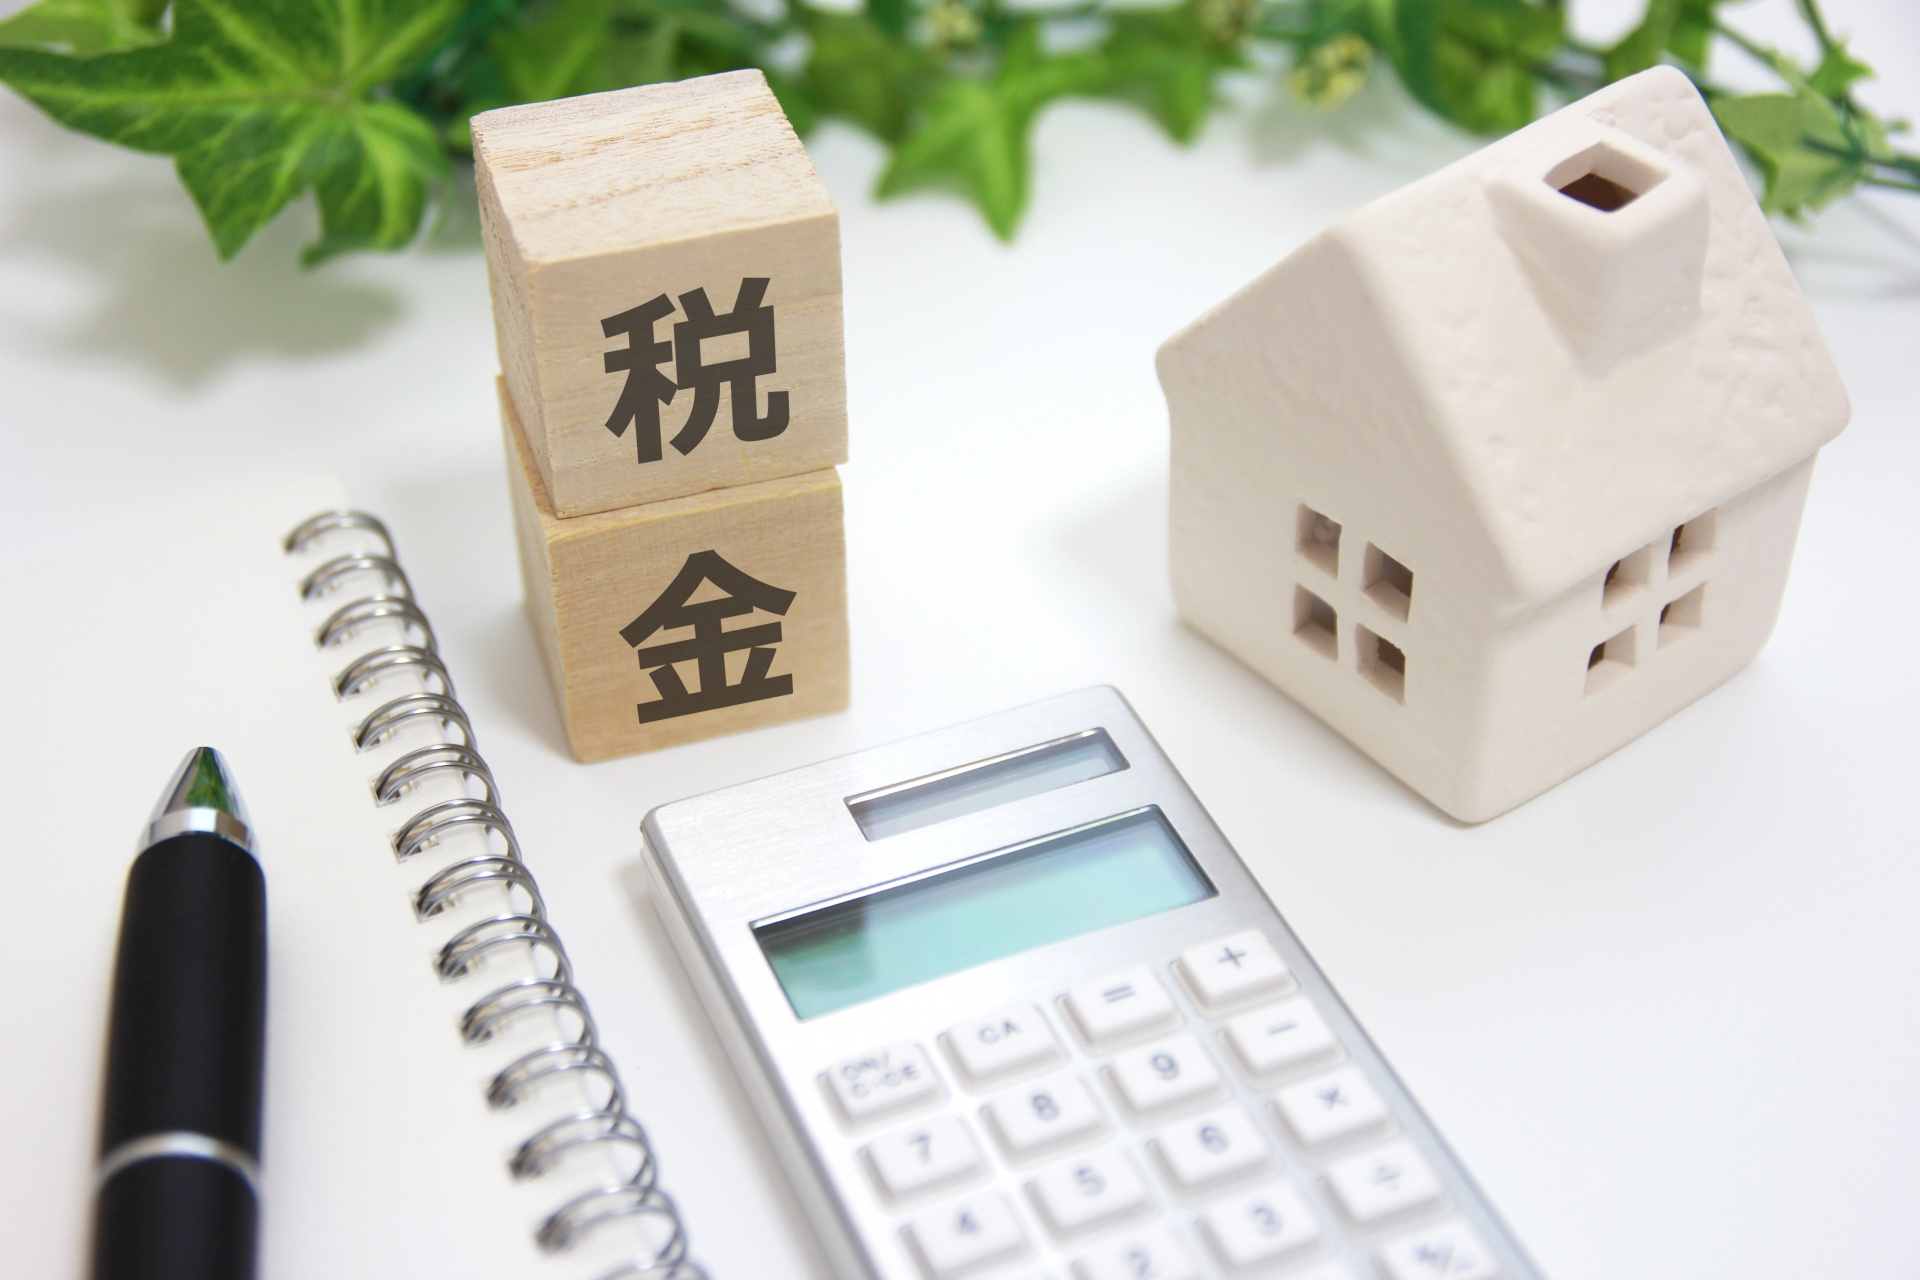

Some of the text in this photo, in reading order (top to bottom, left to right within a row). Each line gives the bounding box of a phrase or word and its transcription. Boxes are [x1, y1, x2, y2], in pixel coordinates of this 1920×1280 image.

[601, 277, 790, 464] 税
[619, 549, 797, 724] 金
[976, 1018, 1023, 1046] CA
[1150, 1053, 1181, 1082] 9
[1030, 1092, 1061, 1122] 8
[908, 1131, 931, 1165] 7
[1197, 1124, 1230, 1155] 6
[1072, 1166, 1106, 1197] 5
[954, 1207, 982, 1238] 4
[1250, 1204, 1285, 1238] 3
